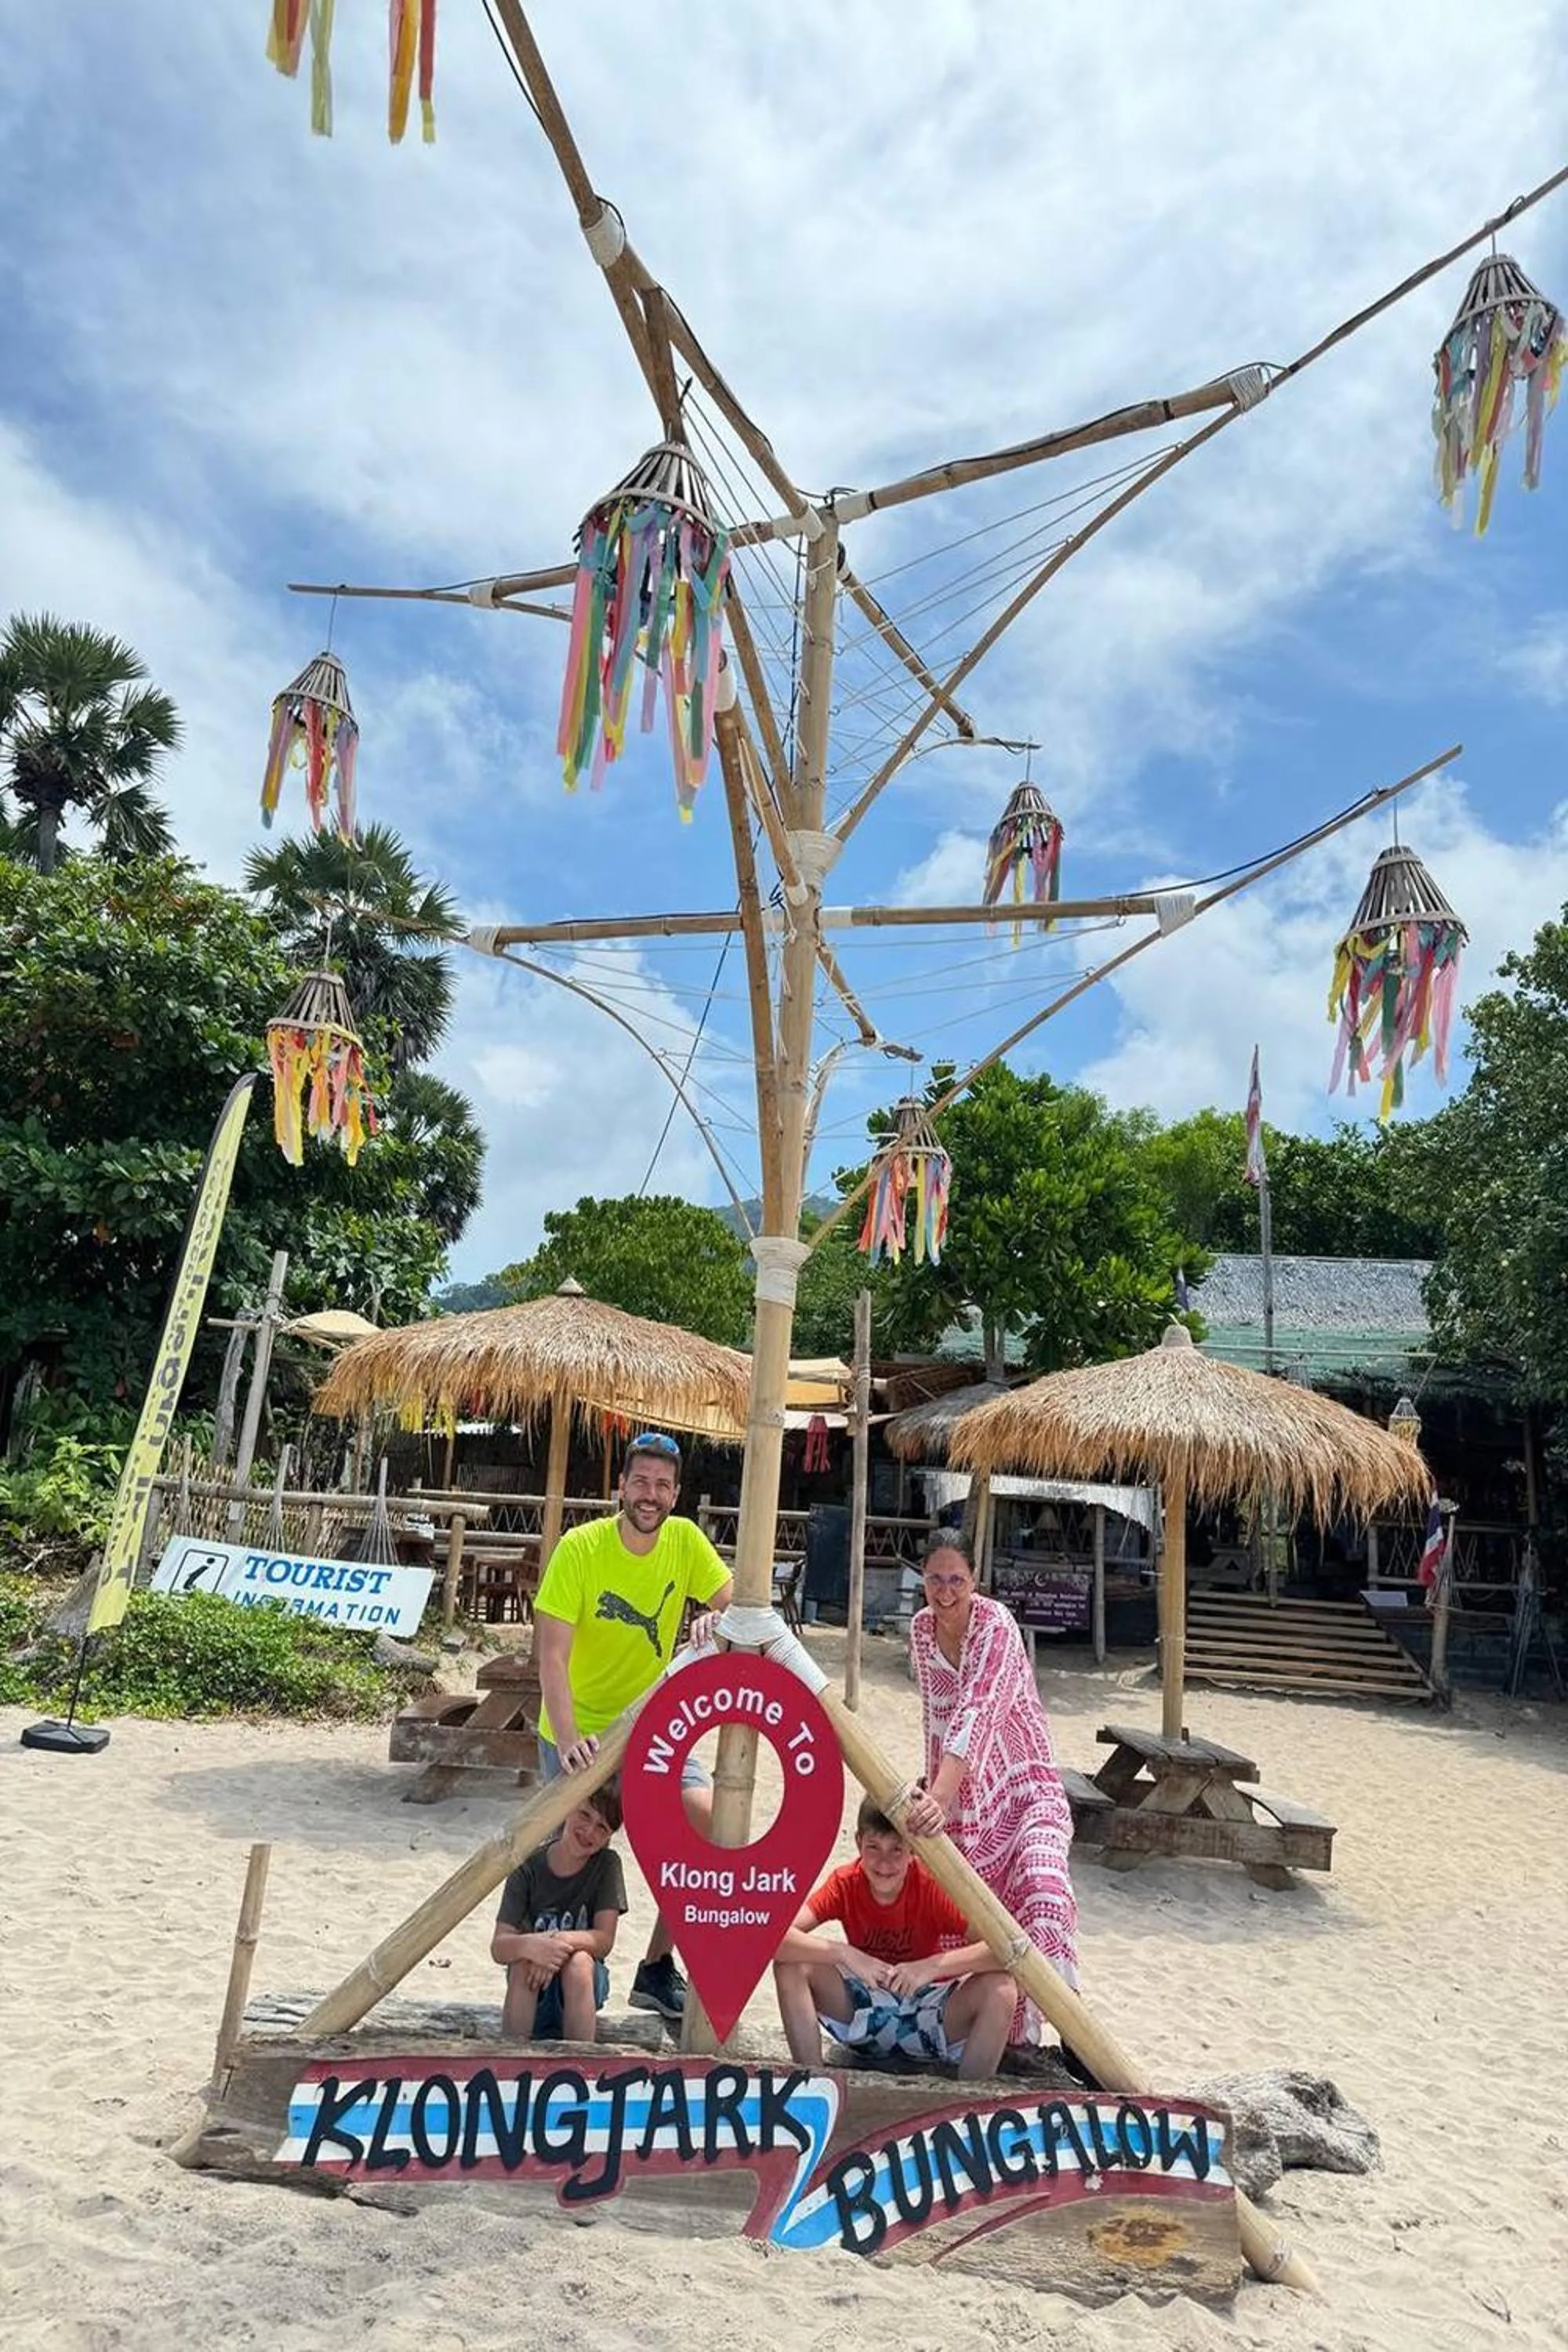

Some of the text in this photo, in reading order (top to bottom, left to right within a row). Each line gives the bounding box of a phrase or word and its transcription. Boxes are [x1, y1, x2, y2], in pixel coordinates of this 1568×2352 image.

[245, 1555, 392, 1594] TOURIST
[643, 1686, 815, 1777] Welcome To
[660, 1862, 797, 1897] Klong Jark
[684, 1905, 771, 1929] Bungalow
[826, 2100, 1210, 2257] BUNGALOW
